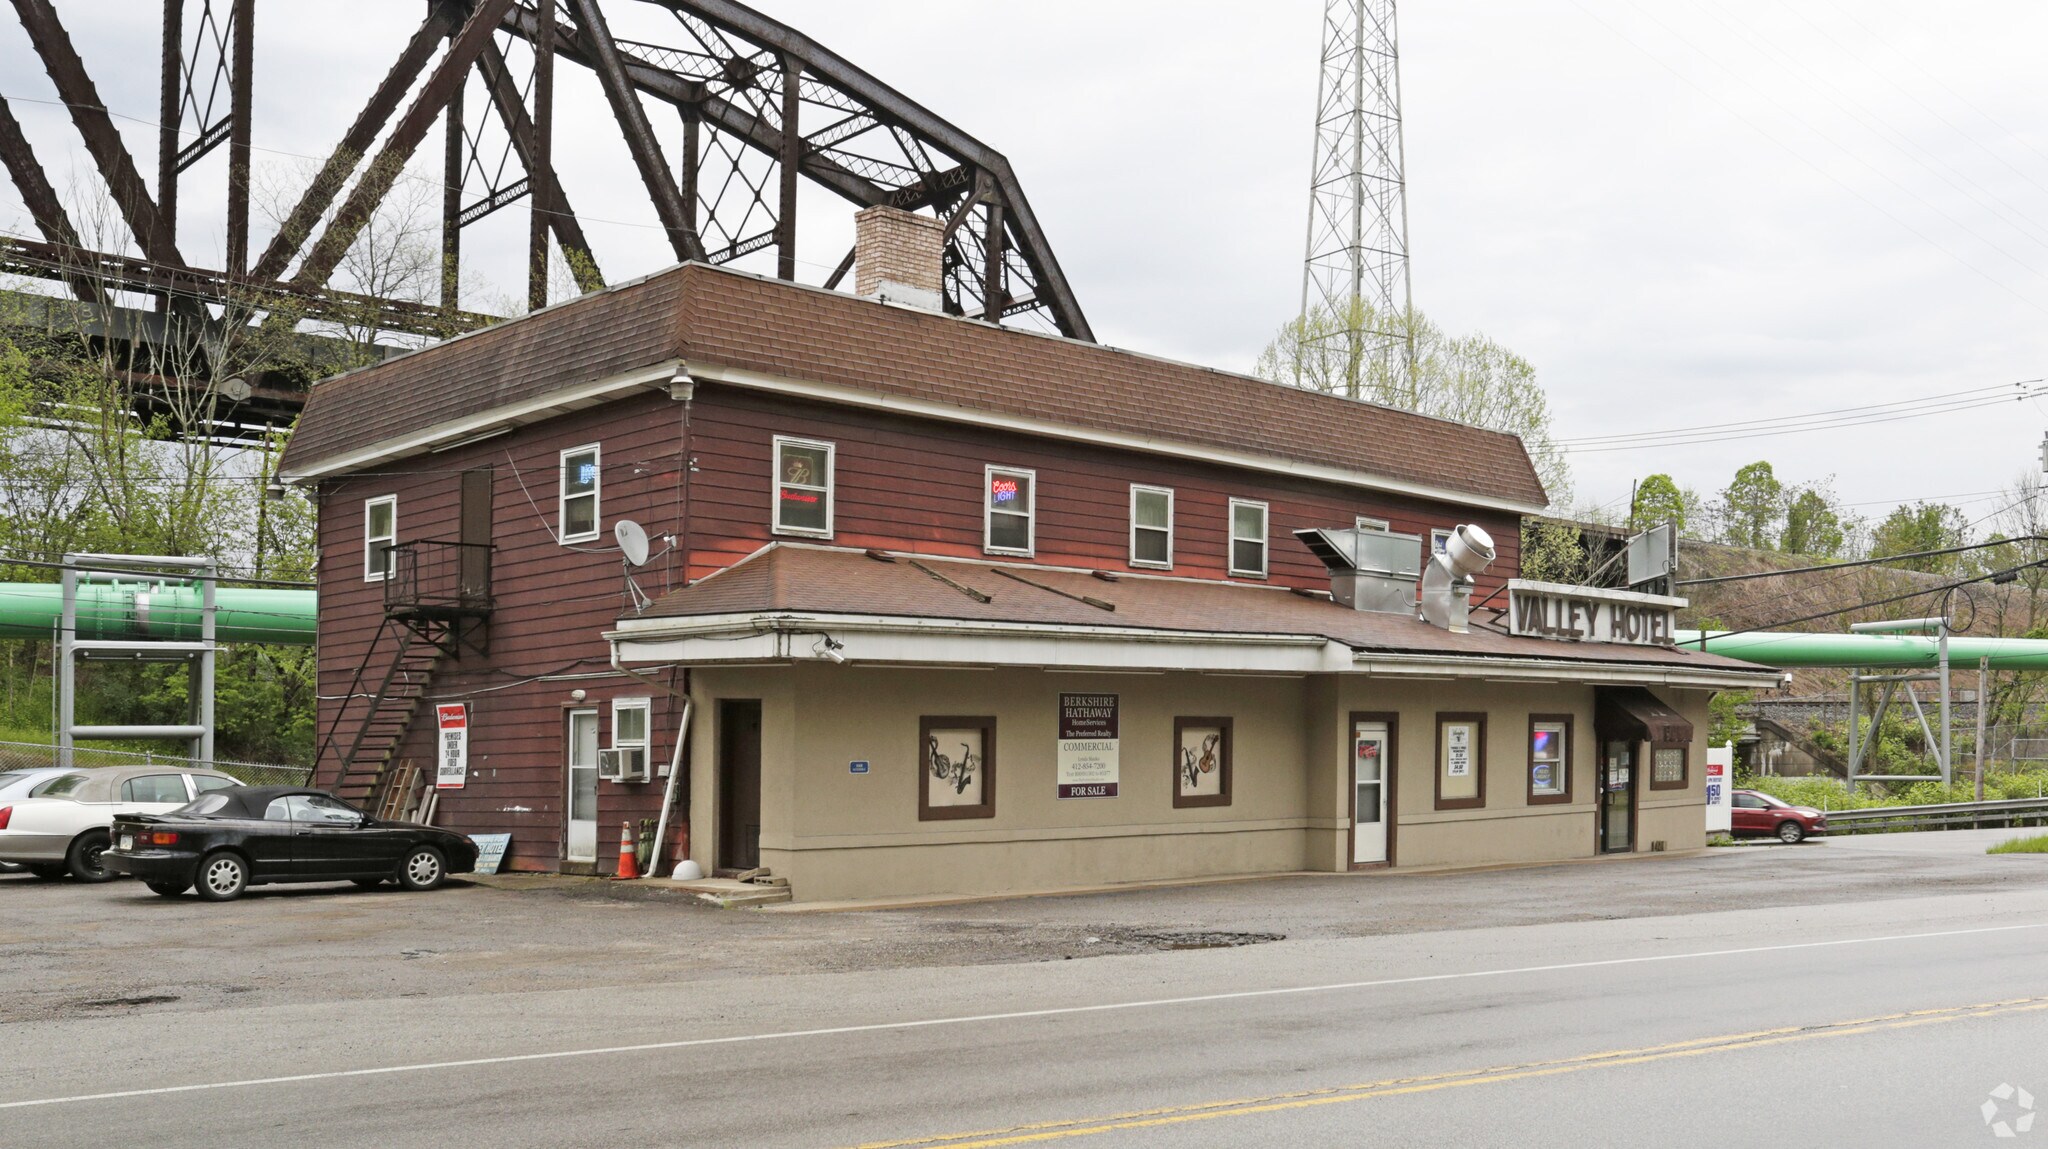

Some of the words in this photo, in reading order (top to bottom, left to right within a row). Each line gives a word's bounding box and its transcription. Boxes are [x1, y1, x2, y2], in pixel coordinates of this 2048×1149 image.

[993, 481, 1017, 493] Coors
[994, 492, 1015, 503] LIGHT
[1514, 594, 1600, 637] VALLEY
[1610, 604, 1675, 644] HOTEL
[1064, 696, 1115, 707] BERKSHIRE
[1065, 707, 1113, 718] HATHAWAY
[444, 732, 461, 741] PREMISES
[1097, 730, 1112, 738] Realty
[1063, 742, 1114, 752] COMMERCIAL
[1071, 786, 1087, 796] FOR
[1087, 786, 1106, 795] SALE
